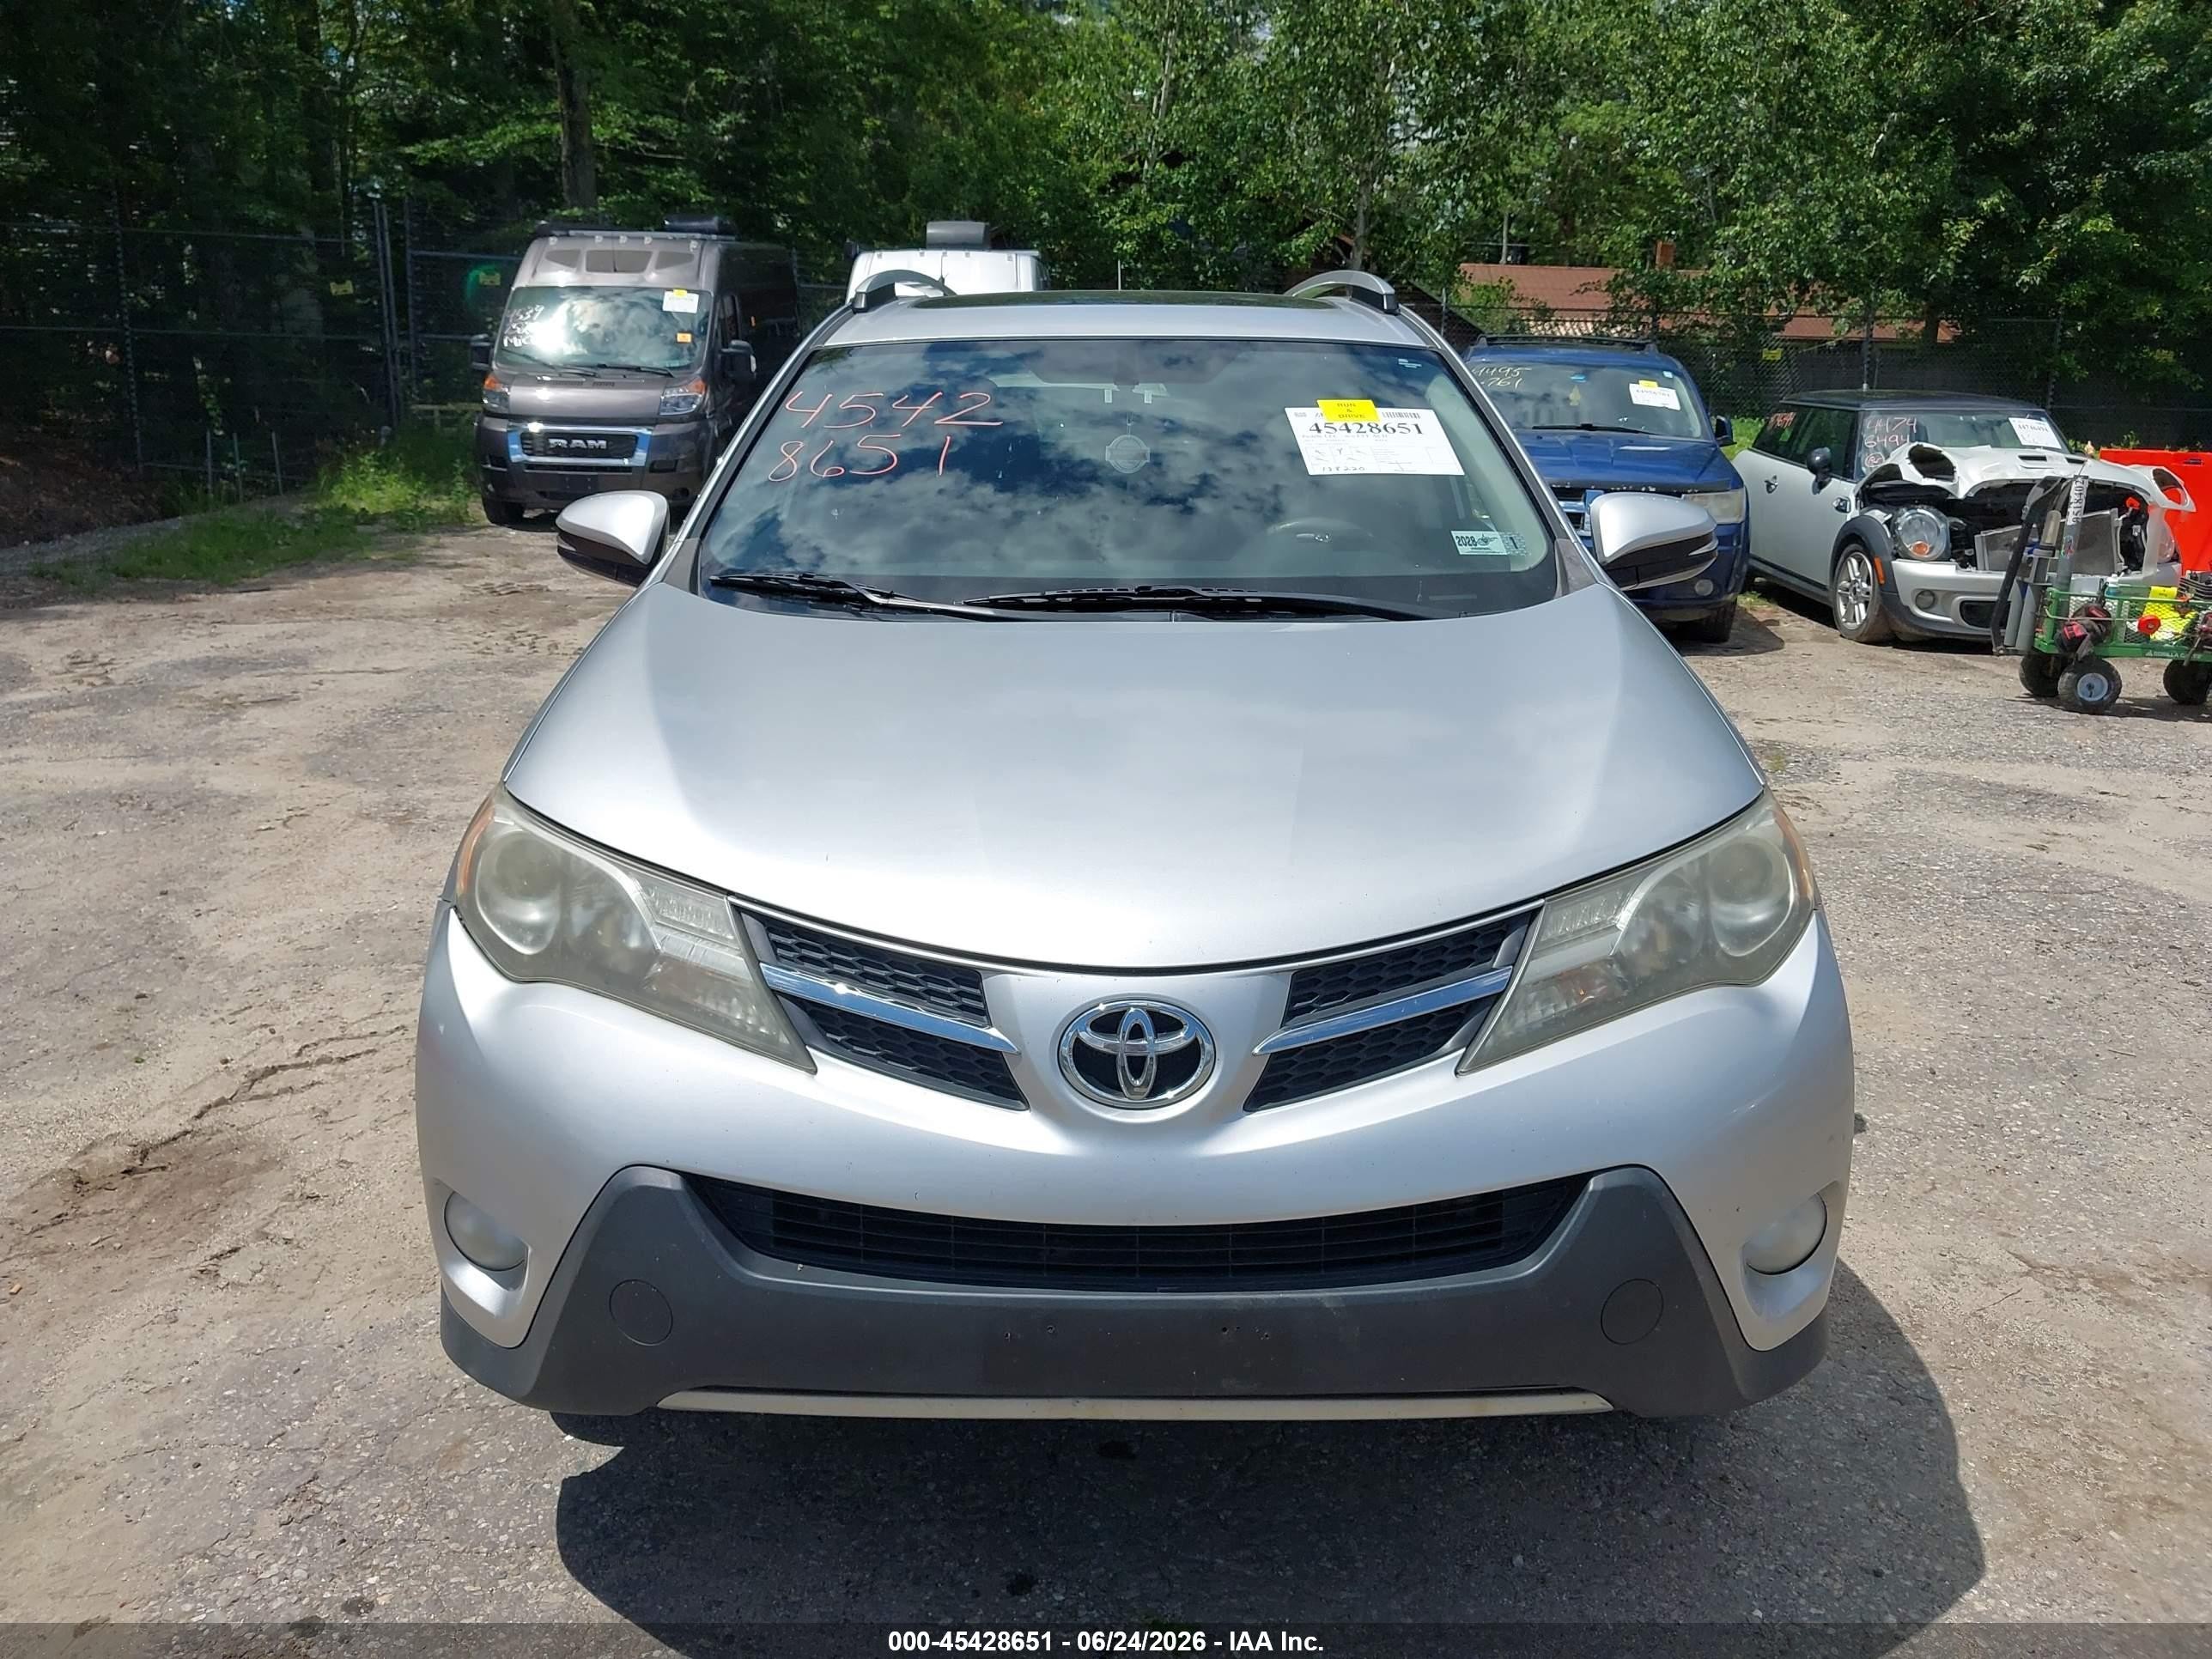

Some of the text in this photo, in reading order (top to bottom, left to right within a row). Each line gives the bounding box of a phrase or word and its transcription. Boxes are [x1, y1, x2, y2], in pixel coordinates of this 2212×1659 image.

[785, 390, 1004, 428] 4542
[1309, 422, 1424, 434] 45428651
[548, 438, 607, 449] RAM
[1864, 434, 1911, 447] 6494
[768, 433, 951, 482] 8651
[1455, 535, 1478, 547] 2028
